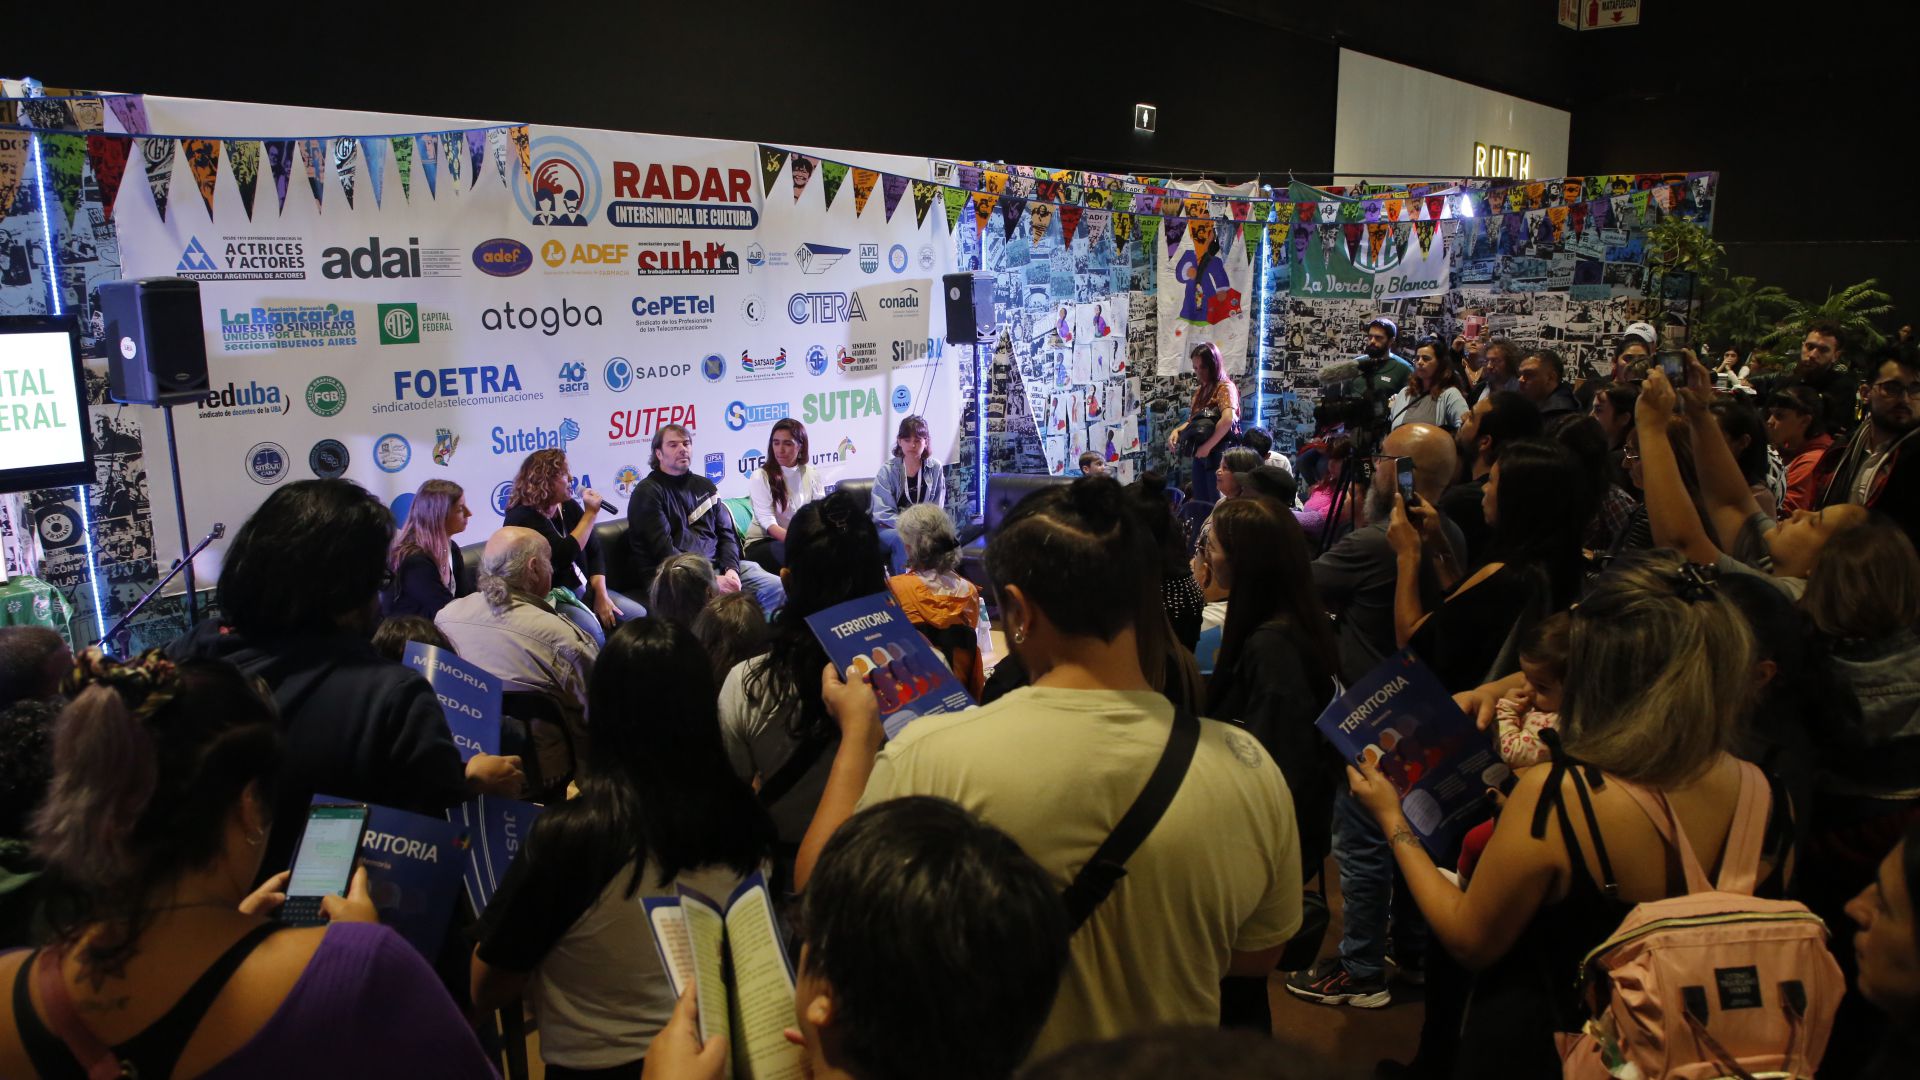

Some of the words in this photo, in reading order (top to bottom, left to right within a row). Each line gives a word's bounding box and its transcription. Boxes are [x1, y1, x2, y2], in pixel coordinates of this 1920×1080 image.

[1474, 142, 1531, 181] RUTH
[613, 161, 752, 203] RADAR
[615, 206, 694, 225] INTERSINDICAL
[696, 209, 708, 225] DE
[710, 210, 752, 226] CULTURA
[225, 243, 303, 255] ACTRICES
[322, 236, 421, 279] adai
[483, 249, 521, 263] adef
[570, 243, 629, 264] ADEF
[861, 247, 877, 257] APL
[225, 257, 235, 269] Y
[240, 257, 305, 269] ACTORES
[1302, 273, 1322, 294] La
[1326, 274, 1370, 291] Verde
[1374, 284, 1384, 296] y
[1387, 275, 1440, 291] Blanca
[632, 295, 715, 316] CePETel
[787, 291, 867, 324] CTERA
[879, 294, 919, 308] conadu
[222, 323, 284, 333] NUESTRO
[287, 321, 355, 331] SINDICATO
[421, 312, 451, 321] CAPITAL
[422, 322, 453, 332] FEDERAL
[482, 298, 603, 336] atogba
[223, 332, 264, 341] UNIDOS
[268, 331, 290, 340] POR
[293, 330, 306, 338] EL
[310, 328, 356, 337] TRABAJO
[327, 337, 357, 346] AIRES
[892, 338, 942, 361] SiPreBA
[394, 364, 522, 400] FOETRA
[558, 362, 586, 382] 40
[636, 364, 691, 379] SADOP
[314, 391, 339, 404] FGB
[559, 382, 589, 392] sacra
[270, 405, 282, 413] UBA
[729, 402, 789, 430] SUTERH
[803, 388, 882, 424] SUTPA
[609, 404, 697, 440] SUTEPA
[492, 427, 559, 455] Suteba
[812, 453, 839, 465] UTTA
[831, 610, 894, 640] TERRITORIA
[413, 655, 489, 693] MEMORIA
[436, 693, 483, 720] RDAD
[1338, 675, 1409, 735] TERRITORIA
[452, 733, 482, 753] CIA
[503, 810, 519, 861] JUS
[362, 830, 438, 864] RITORIA
